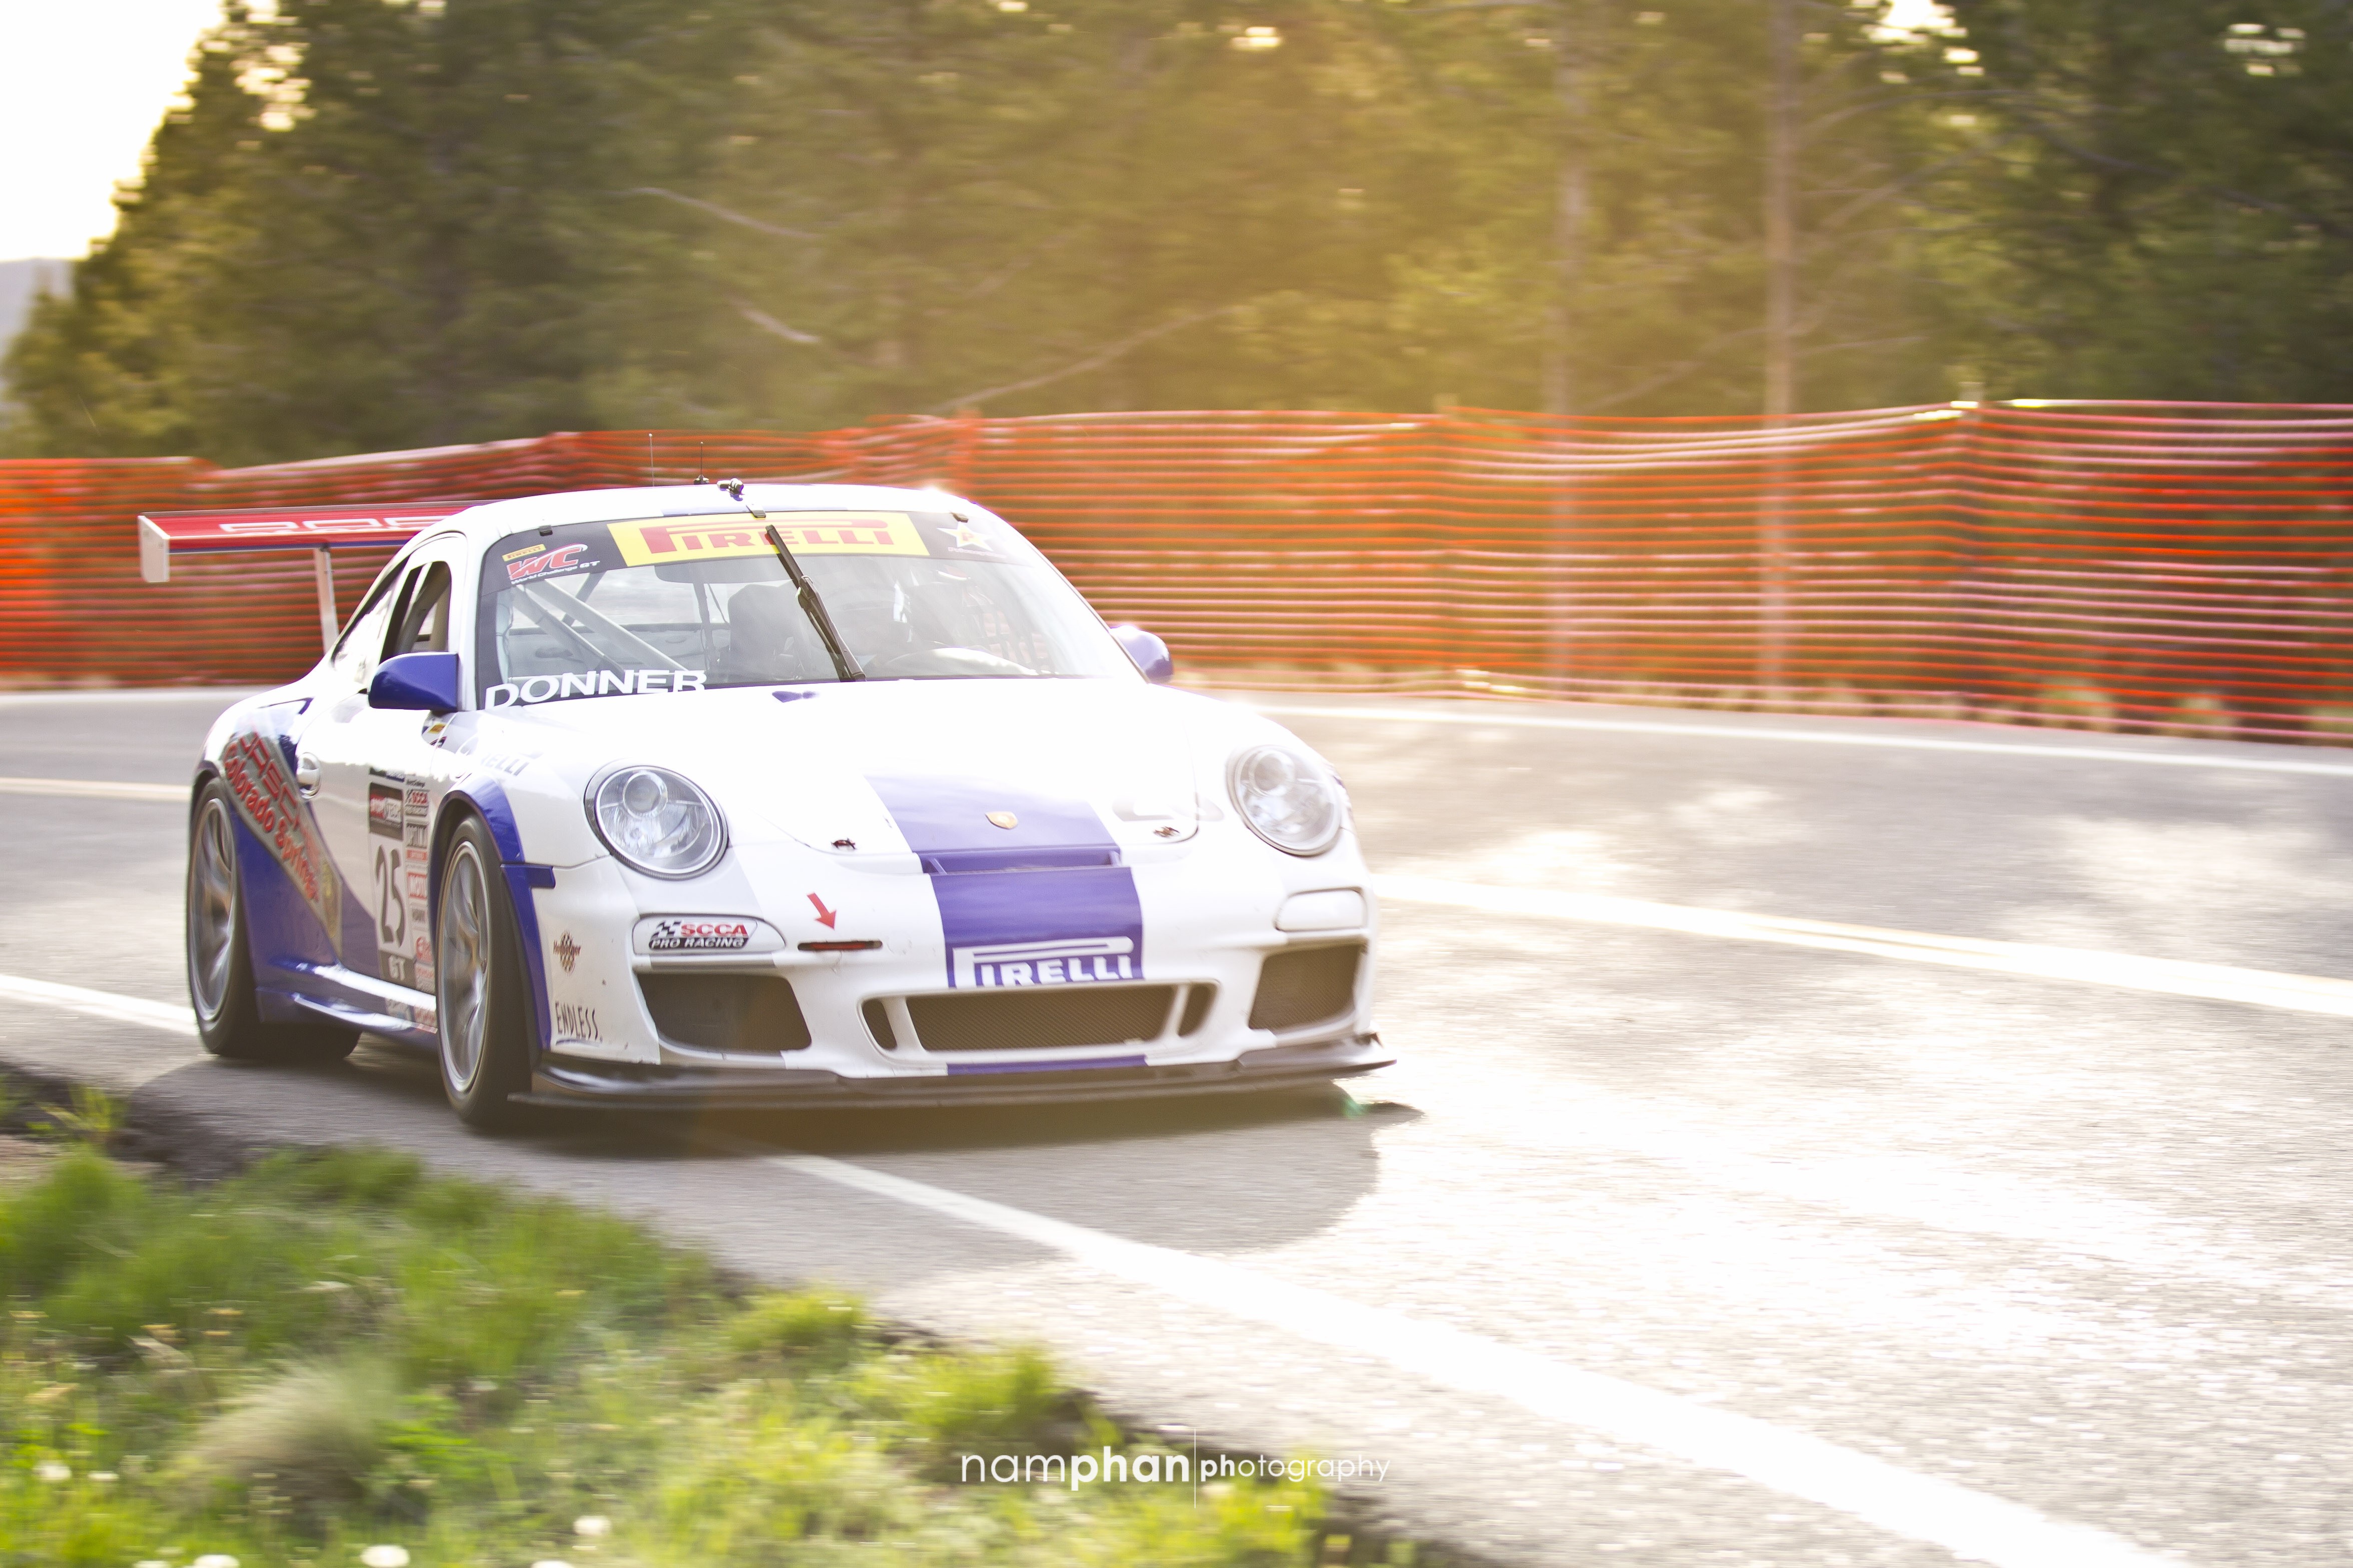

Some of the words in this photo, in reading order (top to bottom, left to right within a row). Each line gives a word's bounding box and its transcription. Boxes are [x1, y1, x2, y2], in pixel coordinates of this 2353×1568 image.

[639, 519, 894, 554] PIRELLI
[506, 546, 583, 580] WC
[579, 560, 600, 569] GT
[485, 669, 707, 709] DONNER
[225, 741, 275, 832] Colorado
[375, 844, 406, 948] 25
[651, 938, 681, 948] PRO
[684, 937, 744, 948] RACING
[680, 923, 749, 937] SCCA
[952, 936, 1134, 988] PIRELLI
[555, 1000, 599, 1042] ENDLESS
